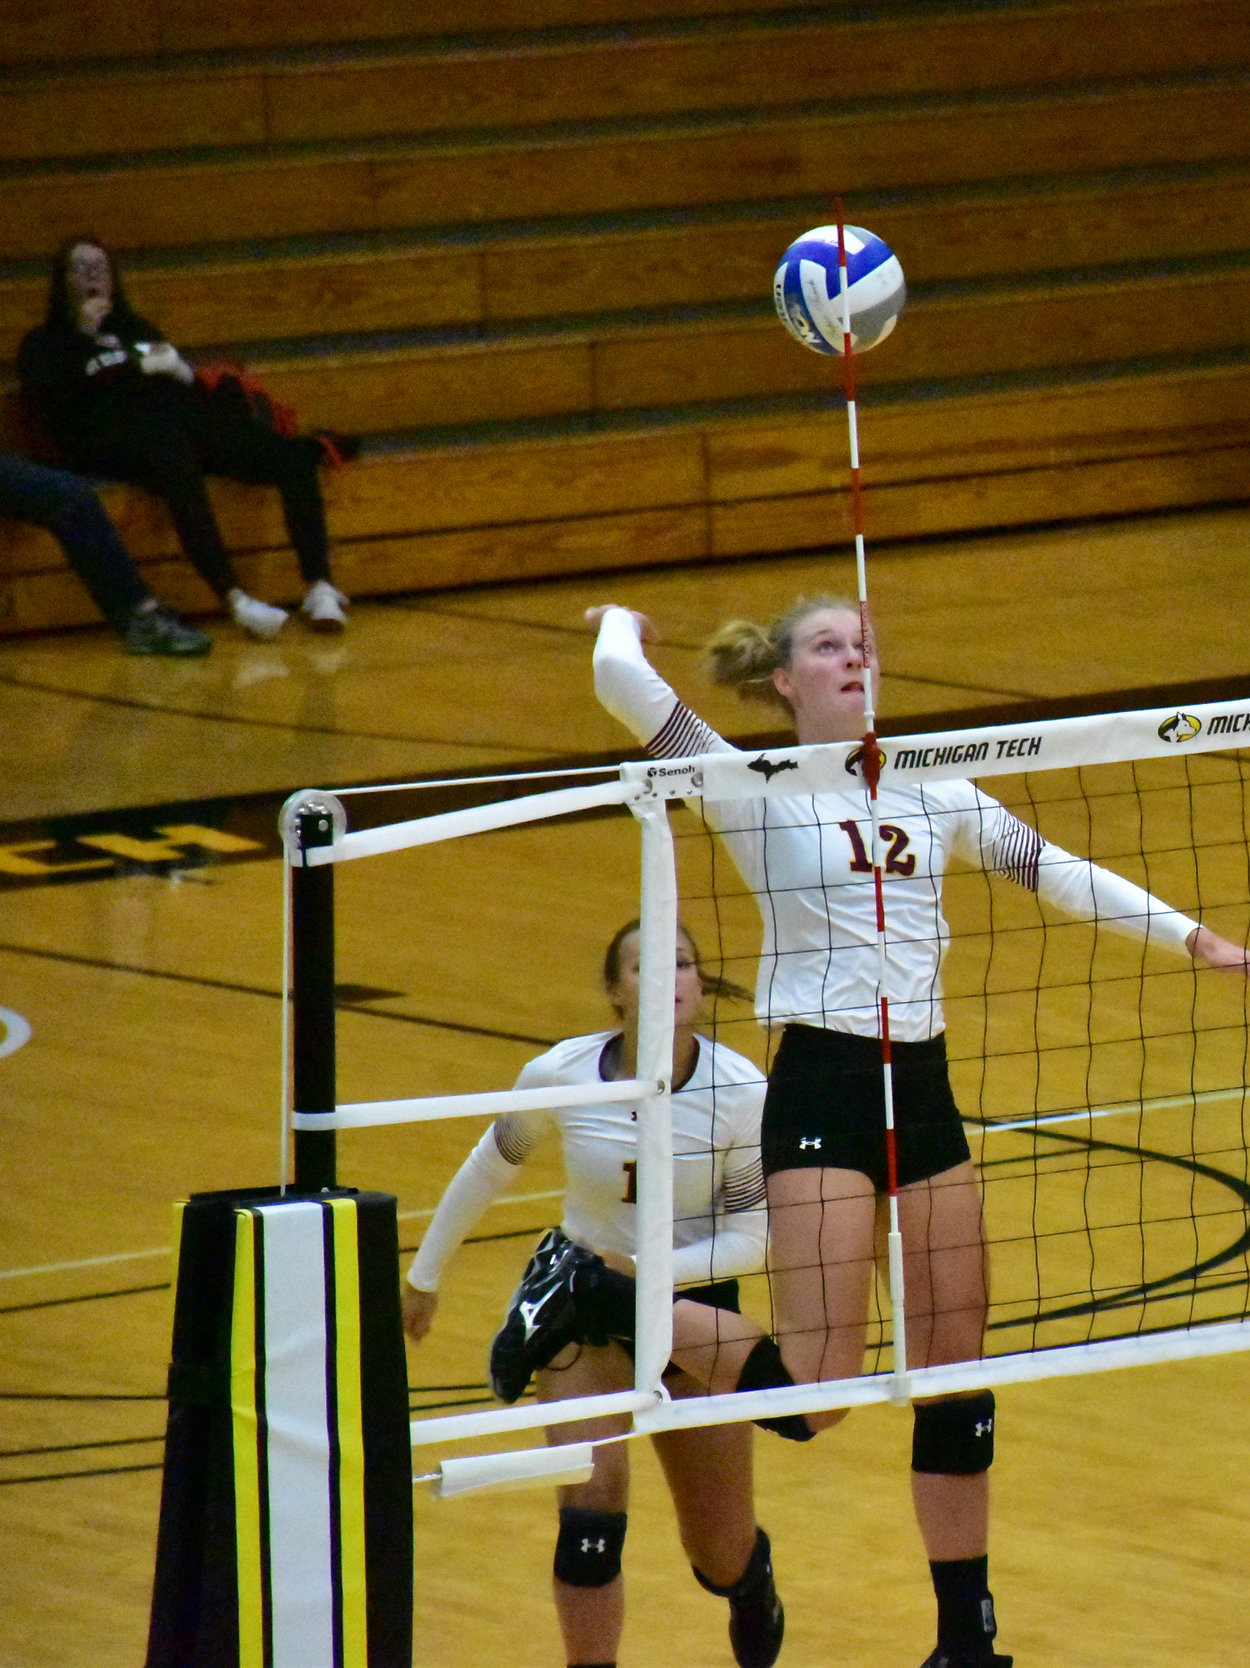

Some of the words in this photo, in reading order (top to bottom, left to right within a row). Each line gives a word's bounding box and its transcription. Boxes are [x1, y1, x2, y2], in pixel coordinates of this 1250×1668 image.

[894, 742, 989, 770] MICHIGAN
[996, 736, 1042, 760] TECH
[658, 765, 696, 777] Senoh
[838, 819, 916, 876] 12
